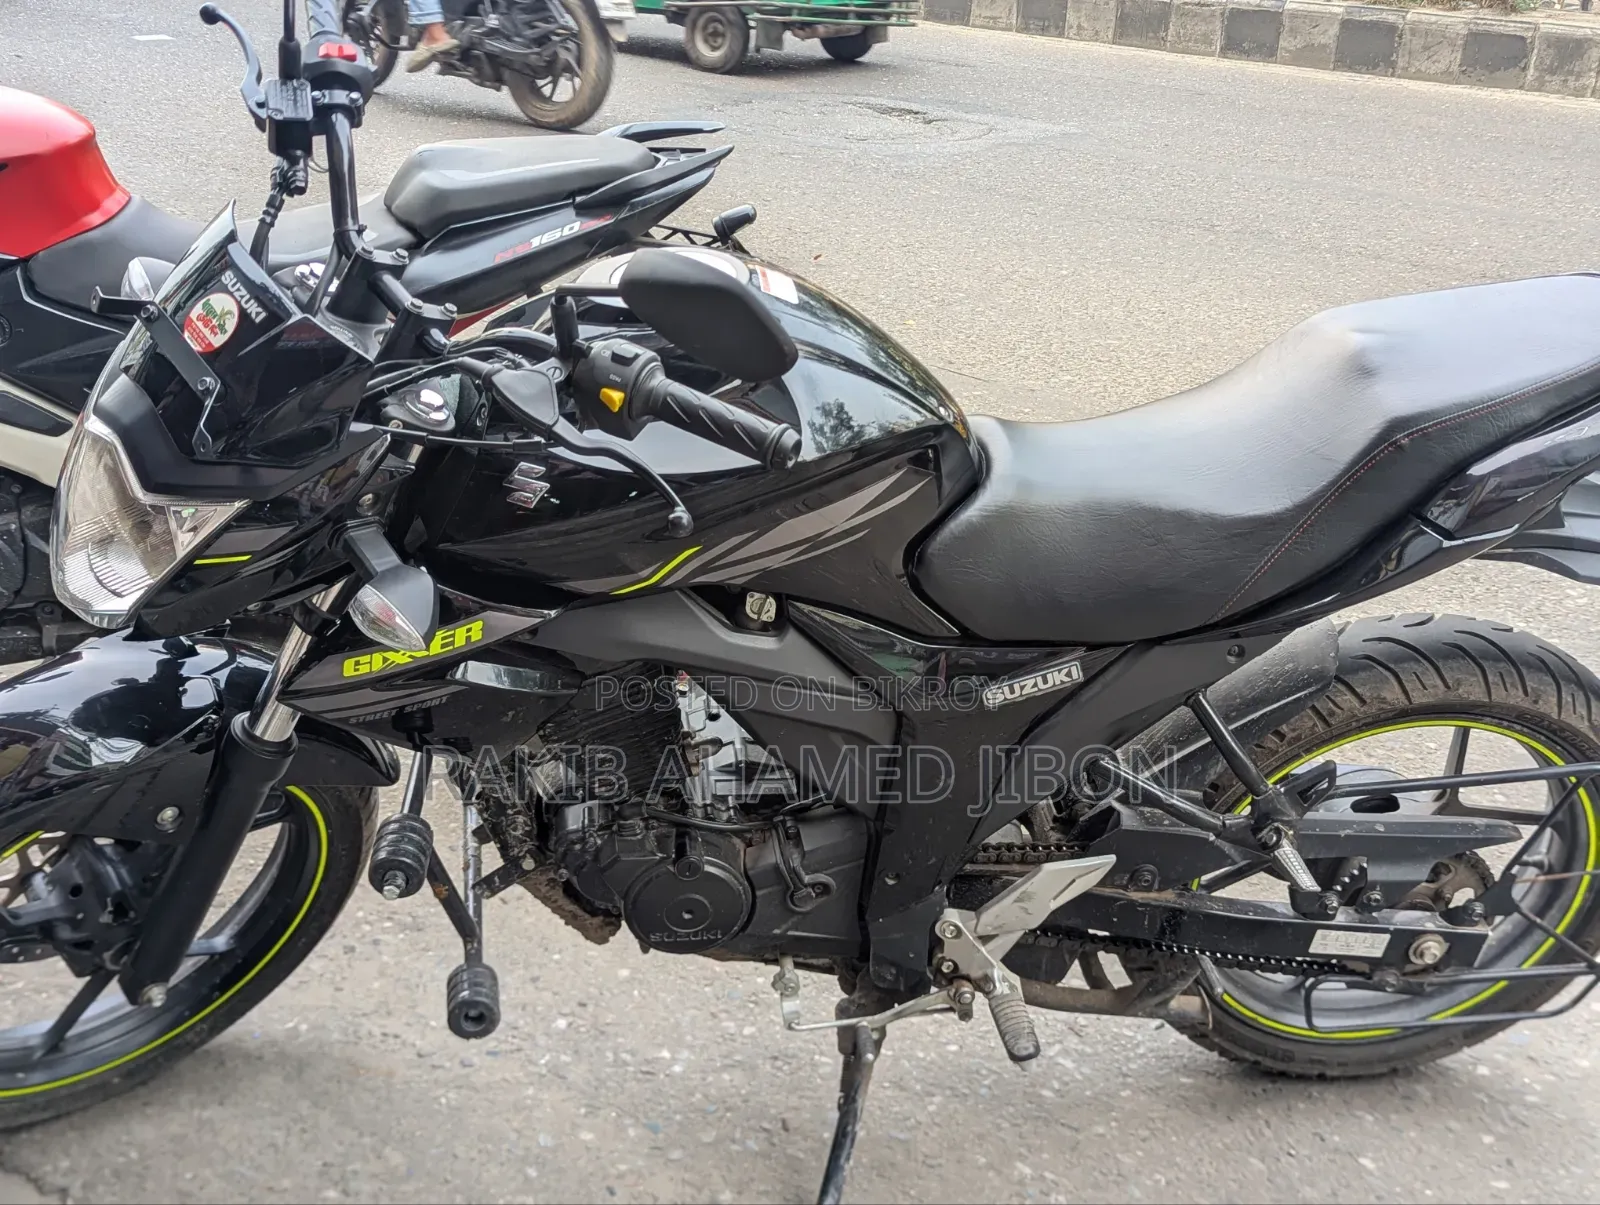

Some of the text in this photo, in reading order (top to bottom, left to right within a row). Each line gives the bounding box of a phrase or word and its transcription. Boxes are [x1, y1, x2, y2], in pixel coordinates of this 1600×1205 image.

[221, 269, 267, 324] SUZUKI
[986, 665, 1079, 704] SUZUKI
[349, 696, 450, 724] STREET SPORT
[649, 929, 722, 942] SUZUKI
